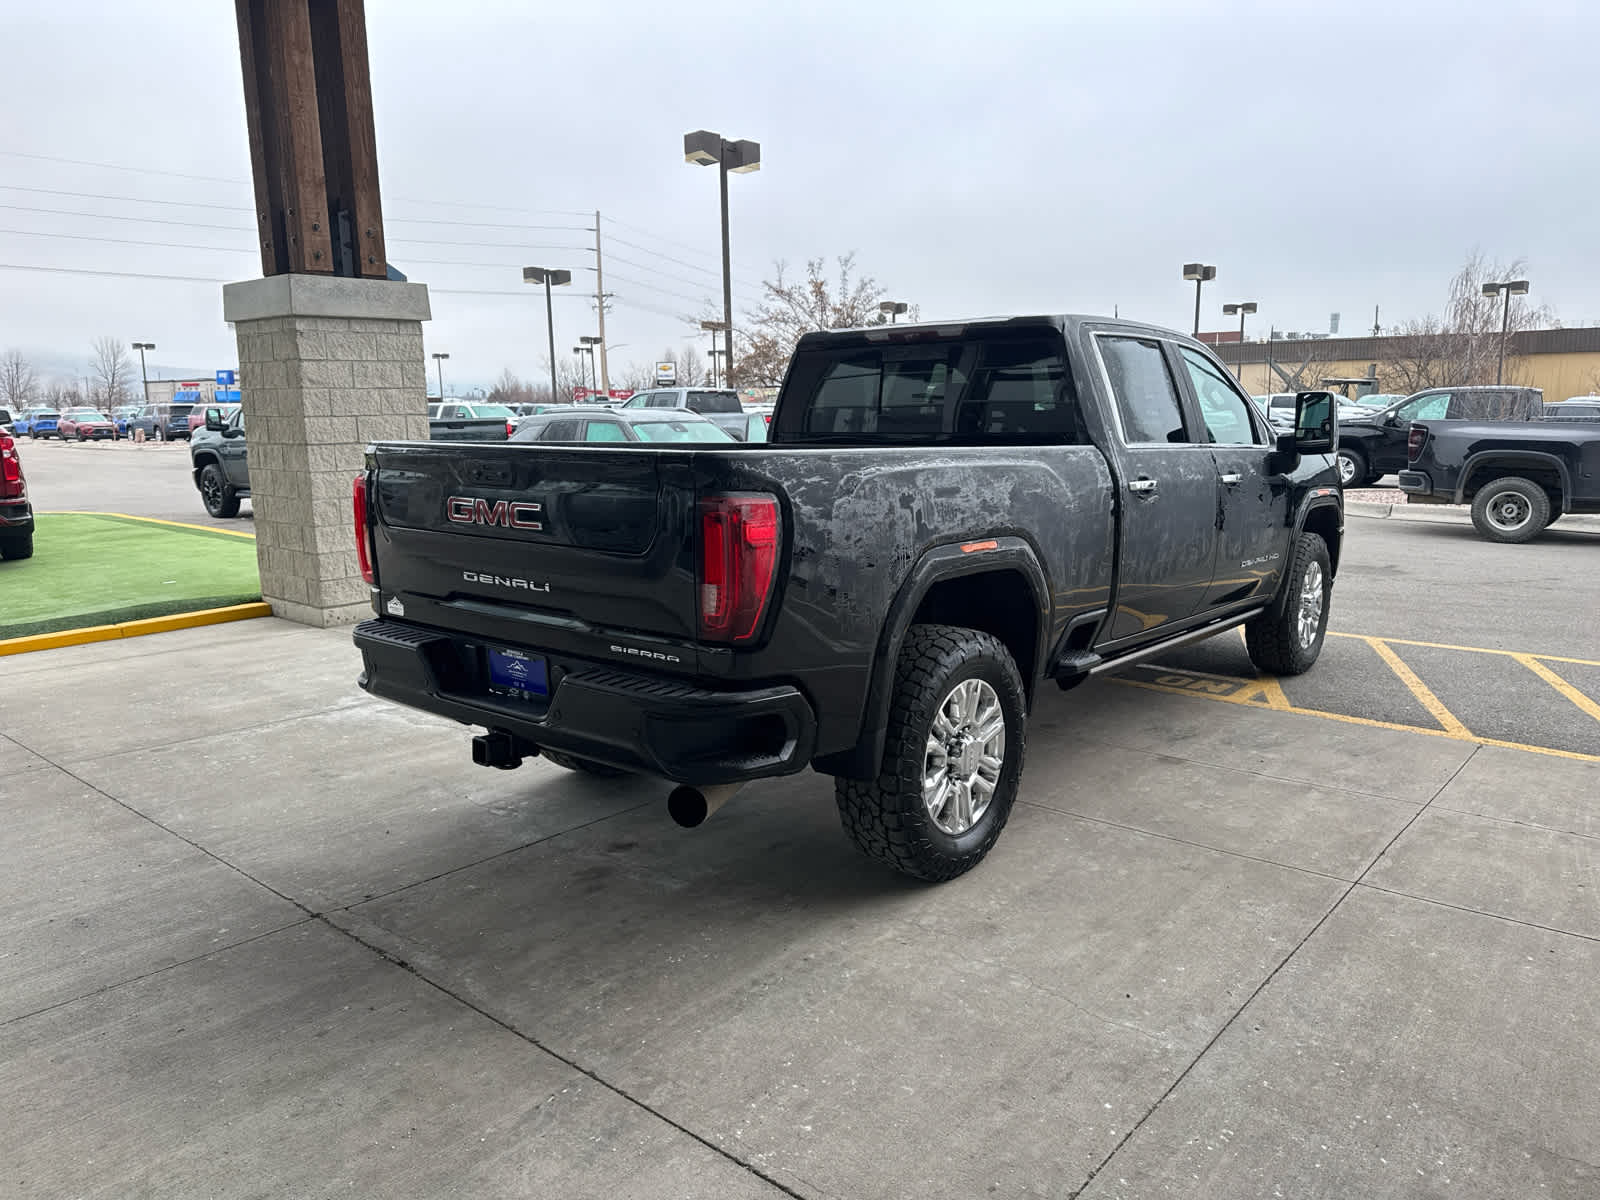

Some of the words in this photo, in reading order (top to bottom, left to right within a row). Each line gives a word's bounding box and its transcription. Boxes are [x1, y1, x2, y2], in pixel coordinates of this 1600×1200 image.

[447, 496, 542, 530] GMC
[463, 571, 550, 592] DENALI
[610, 645, 680, 663] SIERRA
